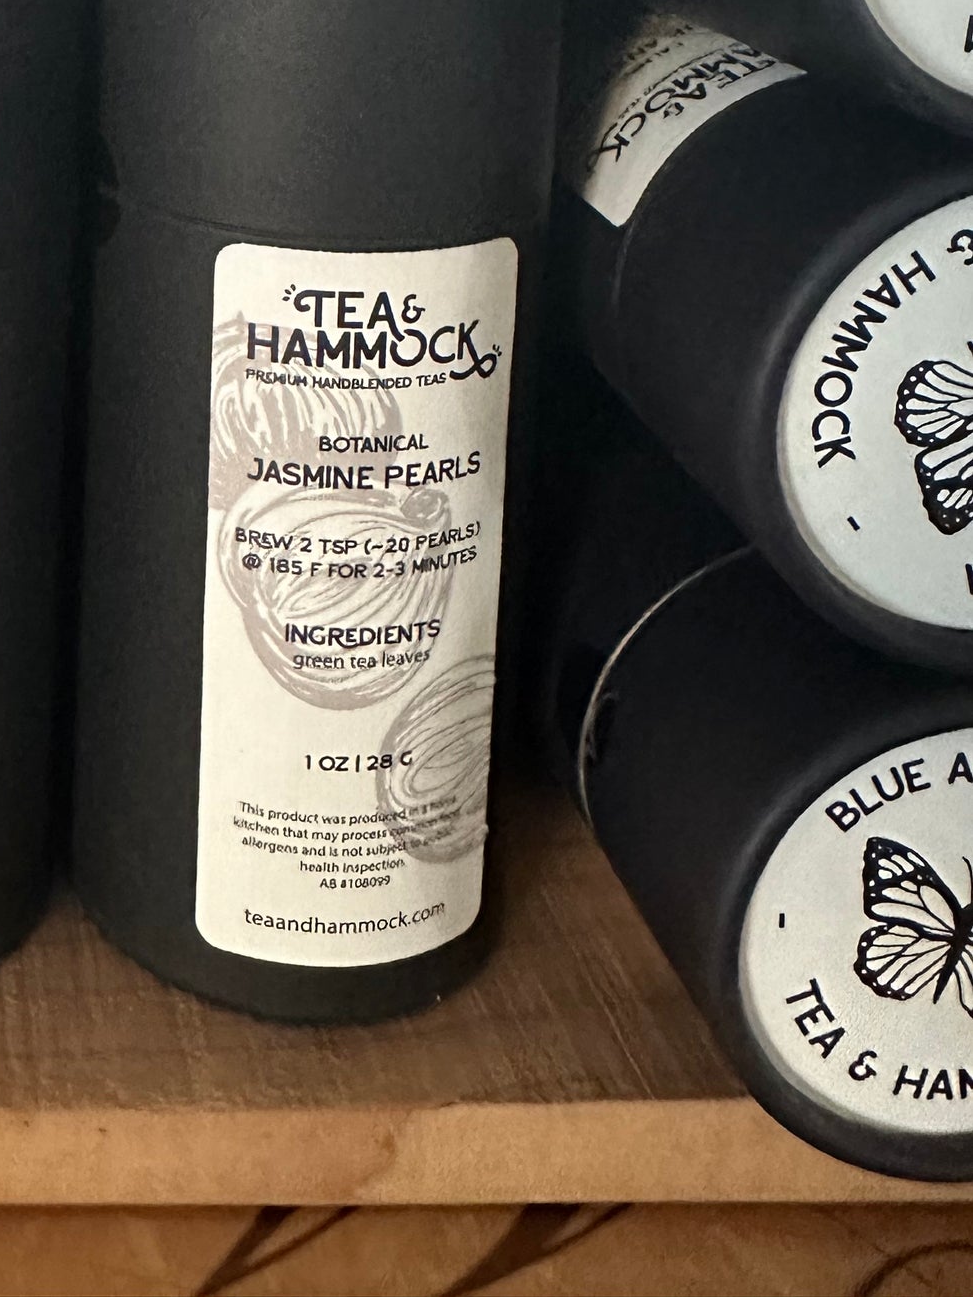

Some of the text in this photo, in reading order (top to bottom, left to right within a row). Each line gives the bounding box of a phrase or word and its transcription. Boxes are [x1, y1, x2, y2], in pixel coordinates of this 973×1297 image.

[293, 289, 426, 342] TEA &
[247, 319, 497, 380] HAMMOCK
[811, 250, 936, 469] HAMMOCK
[245, 368, 447, 390] PREMIUM HANDBLENDED TEAS
[318, 434, 429, 454] BOTANICAL
[247, 450, 481, 490] JASMINE PEARLS
[235, 527, 293, 550] BREW
[300, 537, 312, 553] 2
[318, 538, 357, 554] TSP
[415, 521, 481, 551] PEARLS)
[270, 557, 303, 575] 185
[310, 562, 323, 577] F
[328, 563, 367, 578] FOR
[373, 561, 405, 578] 2-3
[412, 545, 478, 574] MINUTES
[284, 619, 441, 648] INGREDIENTS
[292, 650, 430, 670] green tea leaves
[306, 751, 413, 772] 1 OZ 28 G
[825, 758, 931, 833] BLUE
[239, 801, 264, 817] This
[268, 809, 319, 824] product
[321, 815, 346, 824] was
[283, 826, 308, 839] that
[311, 831, 339, 843] may
[341, 829, 387, 843] process
[302, 846, 326, 857] and
[329, 846, 339, 857] is
[342, 846, 363, 856] not
[300, 860, 339, 873] health
[319, 878, 337, 889] AB
[244, 902, 445, 935] teaandhammock.com
[785, 977, 846, 1059] TEA
[848, 1050, 877, 1081] &
